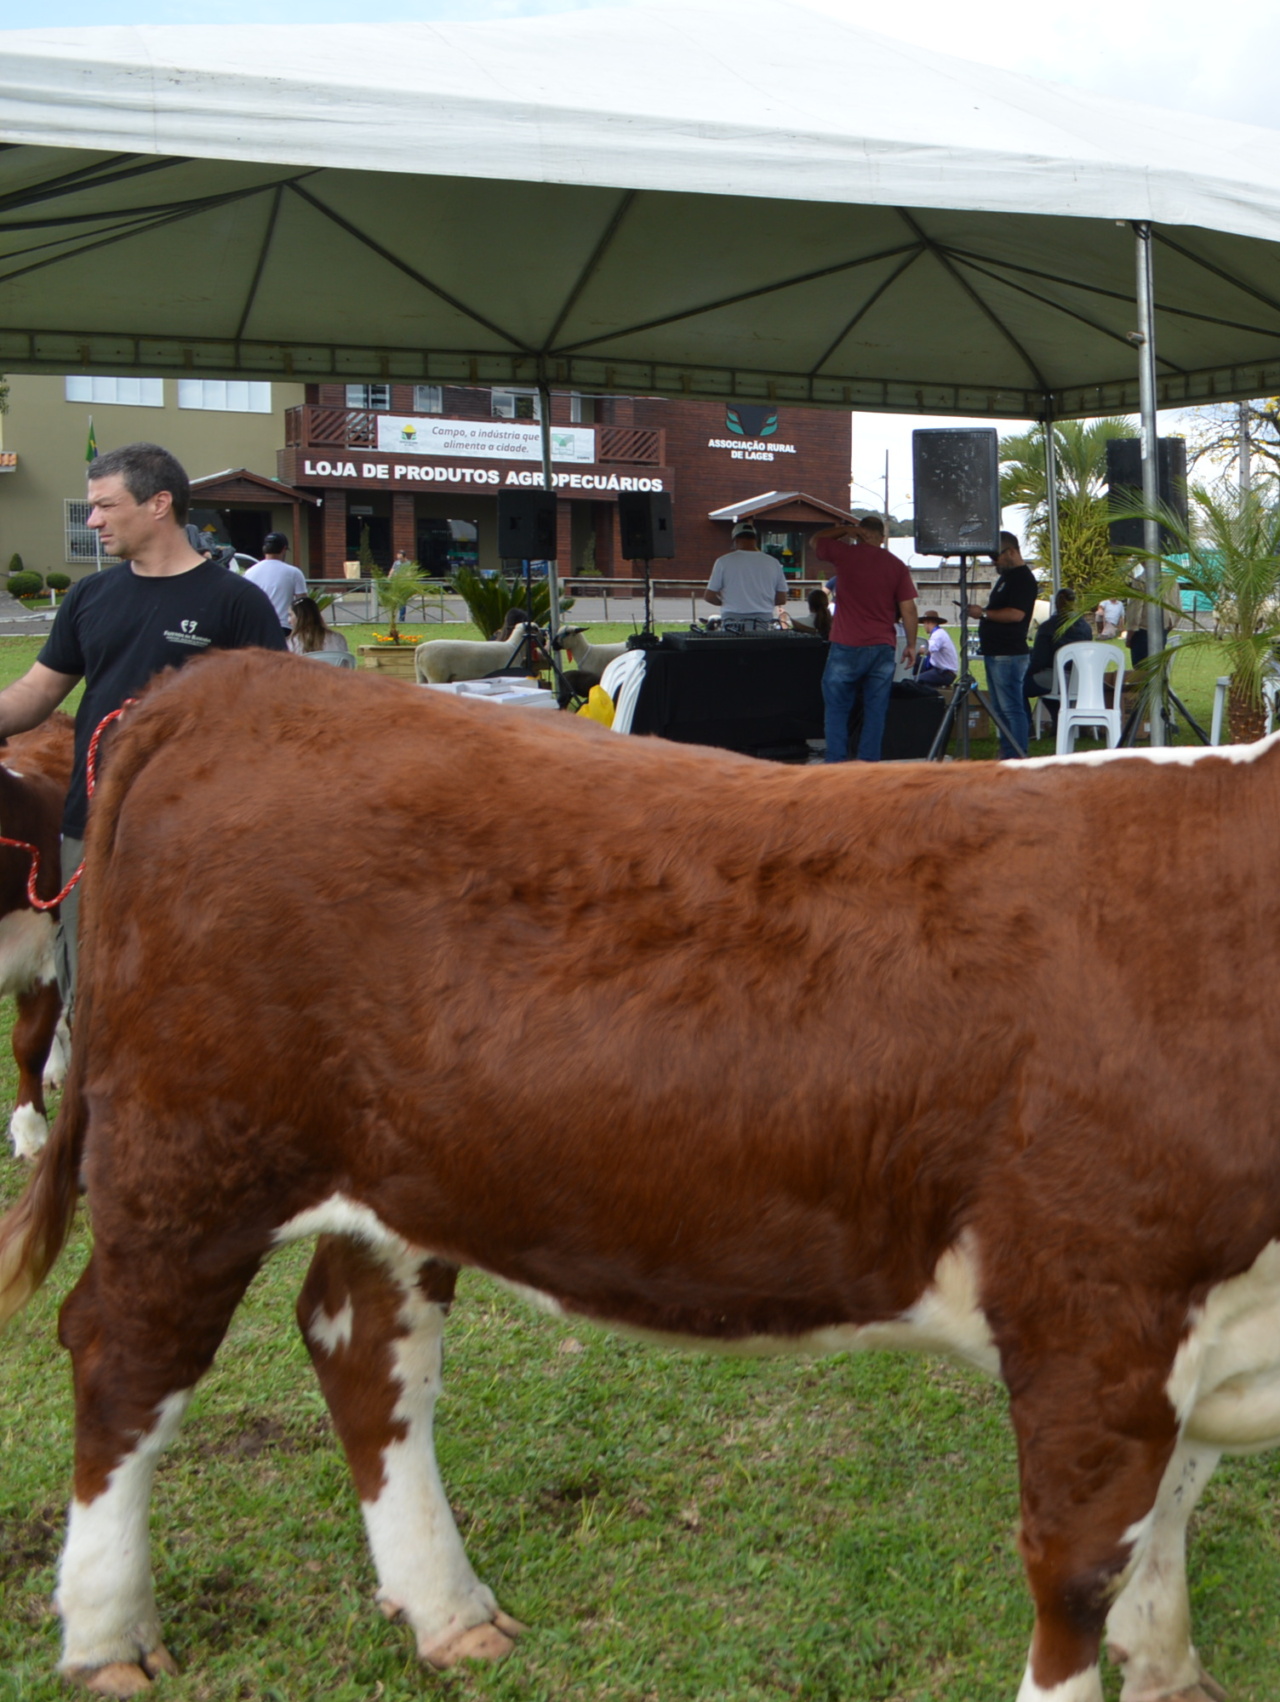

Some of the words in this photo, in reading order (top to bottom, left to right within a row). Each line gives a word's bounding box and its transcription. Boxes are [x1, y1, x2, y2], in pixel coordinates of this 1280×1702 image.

[431, 426, 468, 439] Campo,
[478, 429, 520, 440] indústria
[522, 432, 540, 443] que
[443, 440, 486, 450] alimenta
[496, 442, 529, 453] cidade.
[708, 439, 766, 452] ASSOCIAÇÃO
[767, 443, 797, 454] RURAL
[731, 450, 744, 459] DE
[745, 452, 775, 461] LAGES
[304, 460, 357, 477] LOJA
[362, 463, 389, 479] DE
[394, 465, 500, 484] PRODUTOS
